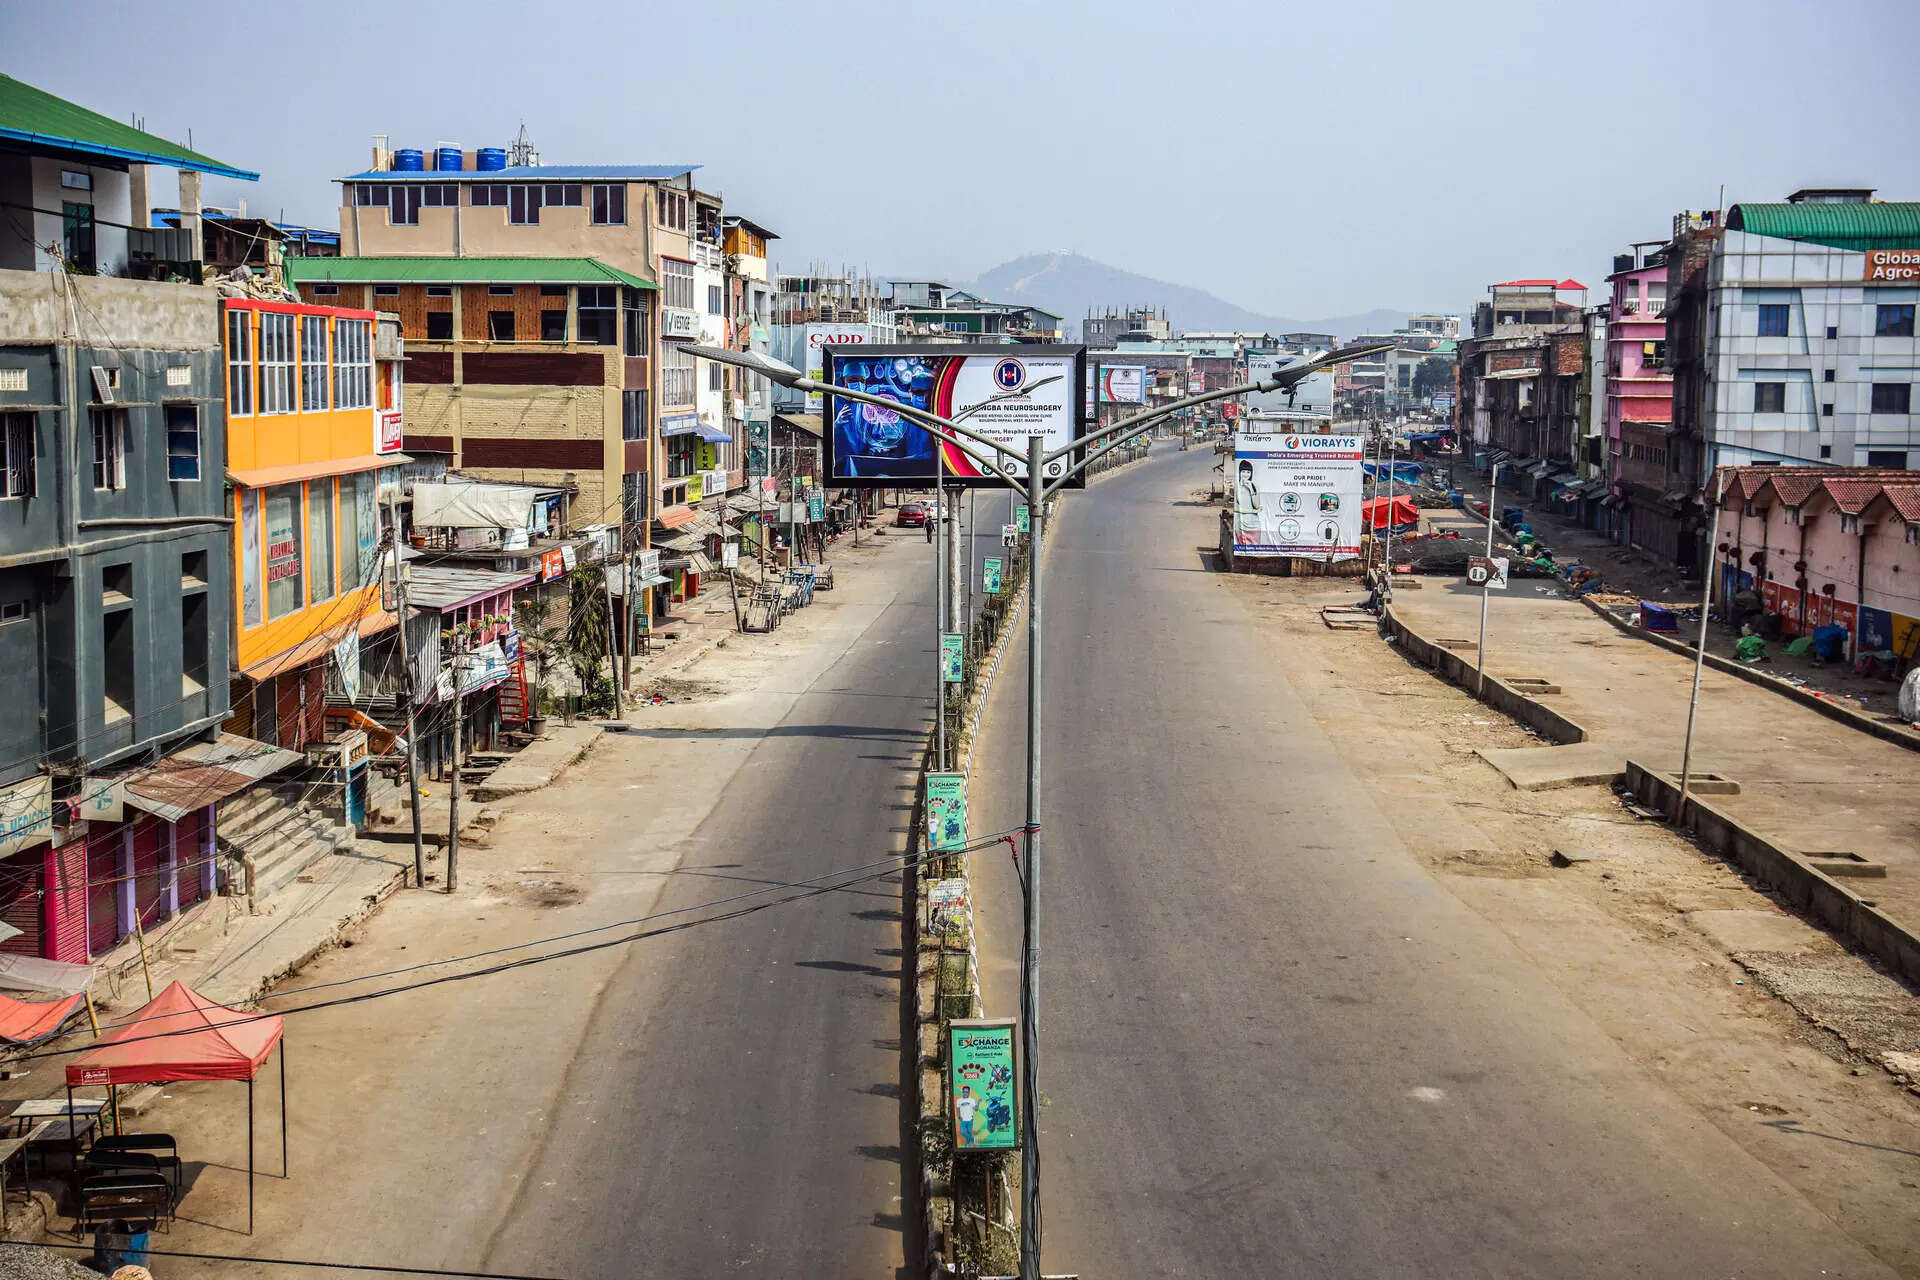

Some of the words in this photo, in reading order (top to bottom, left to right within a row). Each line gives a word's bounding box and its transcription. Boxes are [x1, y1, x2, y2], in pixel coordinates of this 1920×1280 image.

[1872, 266, 1920, 280] Agro-
[674, 315, 690, 330] VESTIGE
[810, 333, 863, 344] CADD
[1301, 438, 1355, 448] VIORAYYS
[958, 1036, 1009, 1047] EXCHANGE
